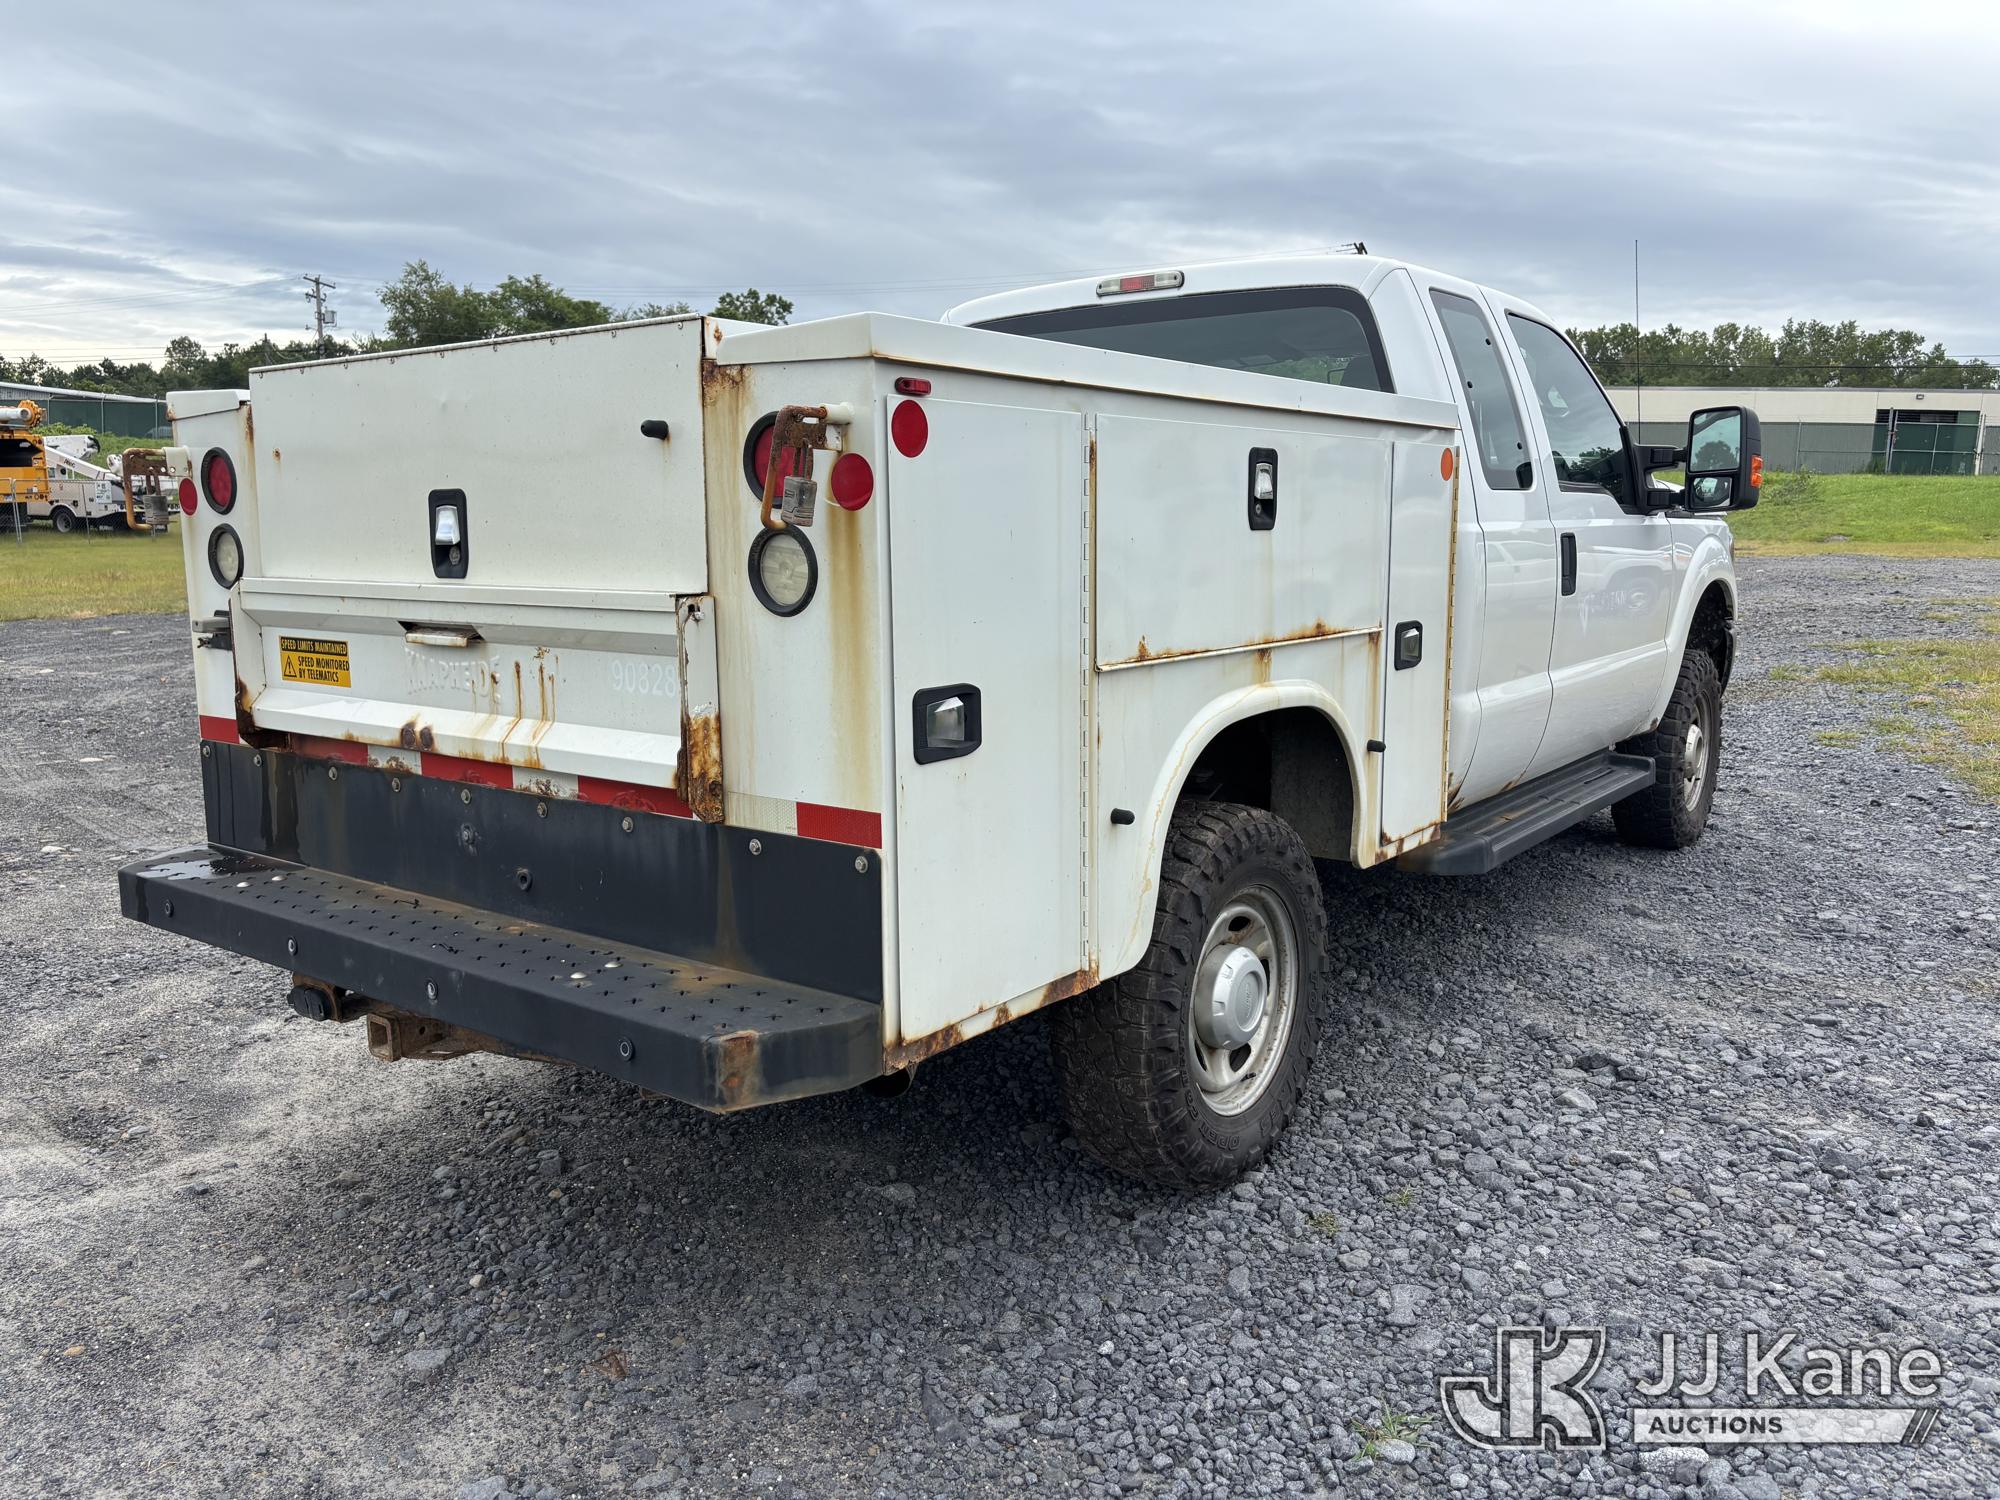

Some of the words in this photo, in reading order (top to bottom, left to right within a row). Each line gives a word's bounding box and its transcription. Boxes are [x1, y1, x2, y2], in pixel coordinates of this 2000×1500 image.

[281, 639, 297, 650] SPEED
[298, 640, 314, 652] LIMITS
[315, 641, 347, 654] MAINTAINED
[298, 656, 314, 668] SPEED
[316, 657, 350, 671] MONITORED
[298, 668, 306, 678] BY
[308, 669, 339, 682] TELEMATICS
[612, 660, 677, 699] 90828
[1199, 1120, 1241, 1150] OPEN
